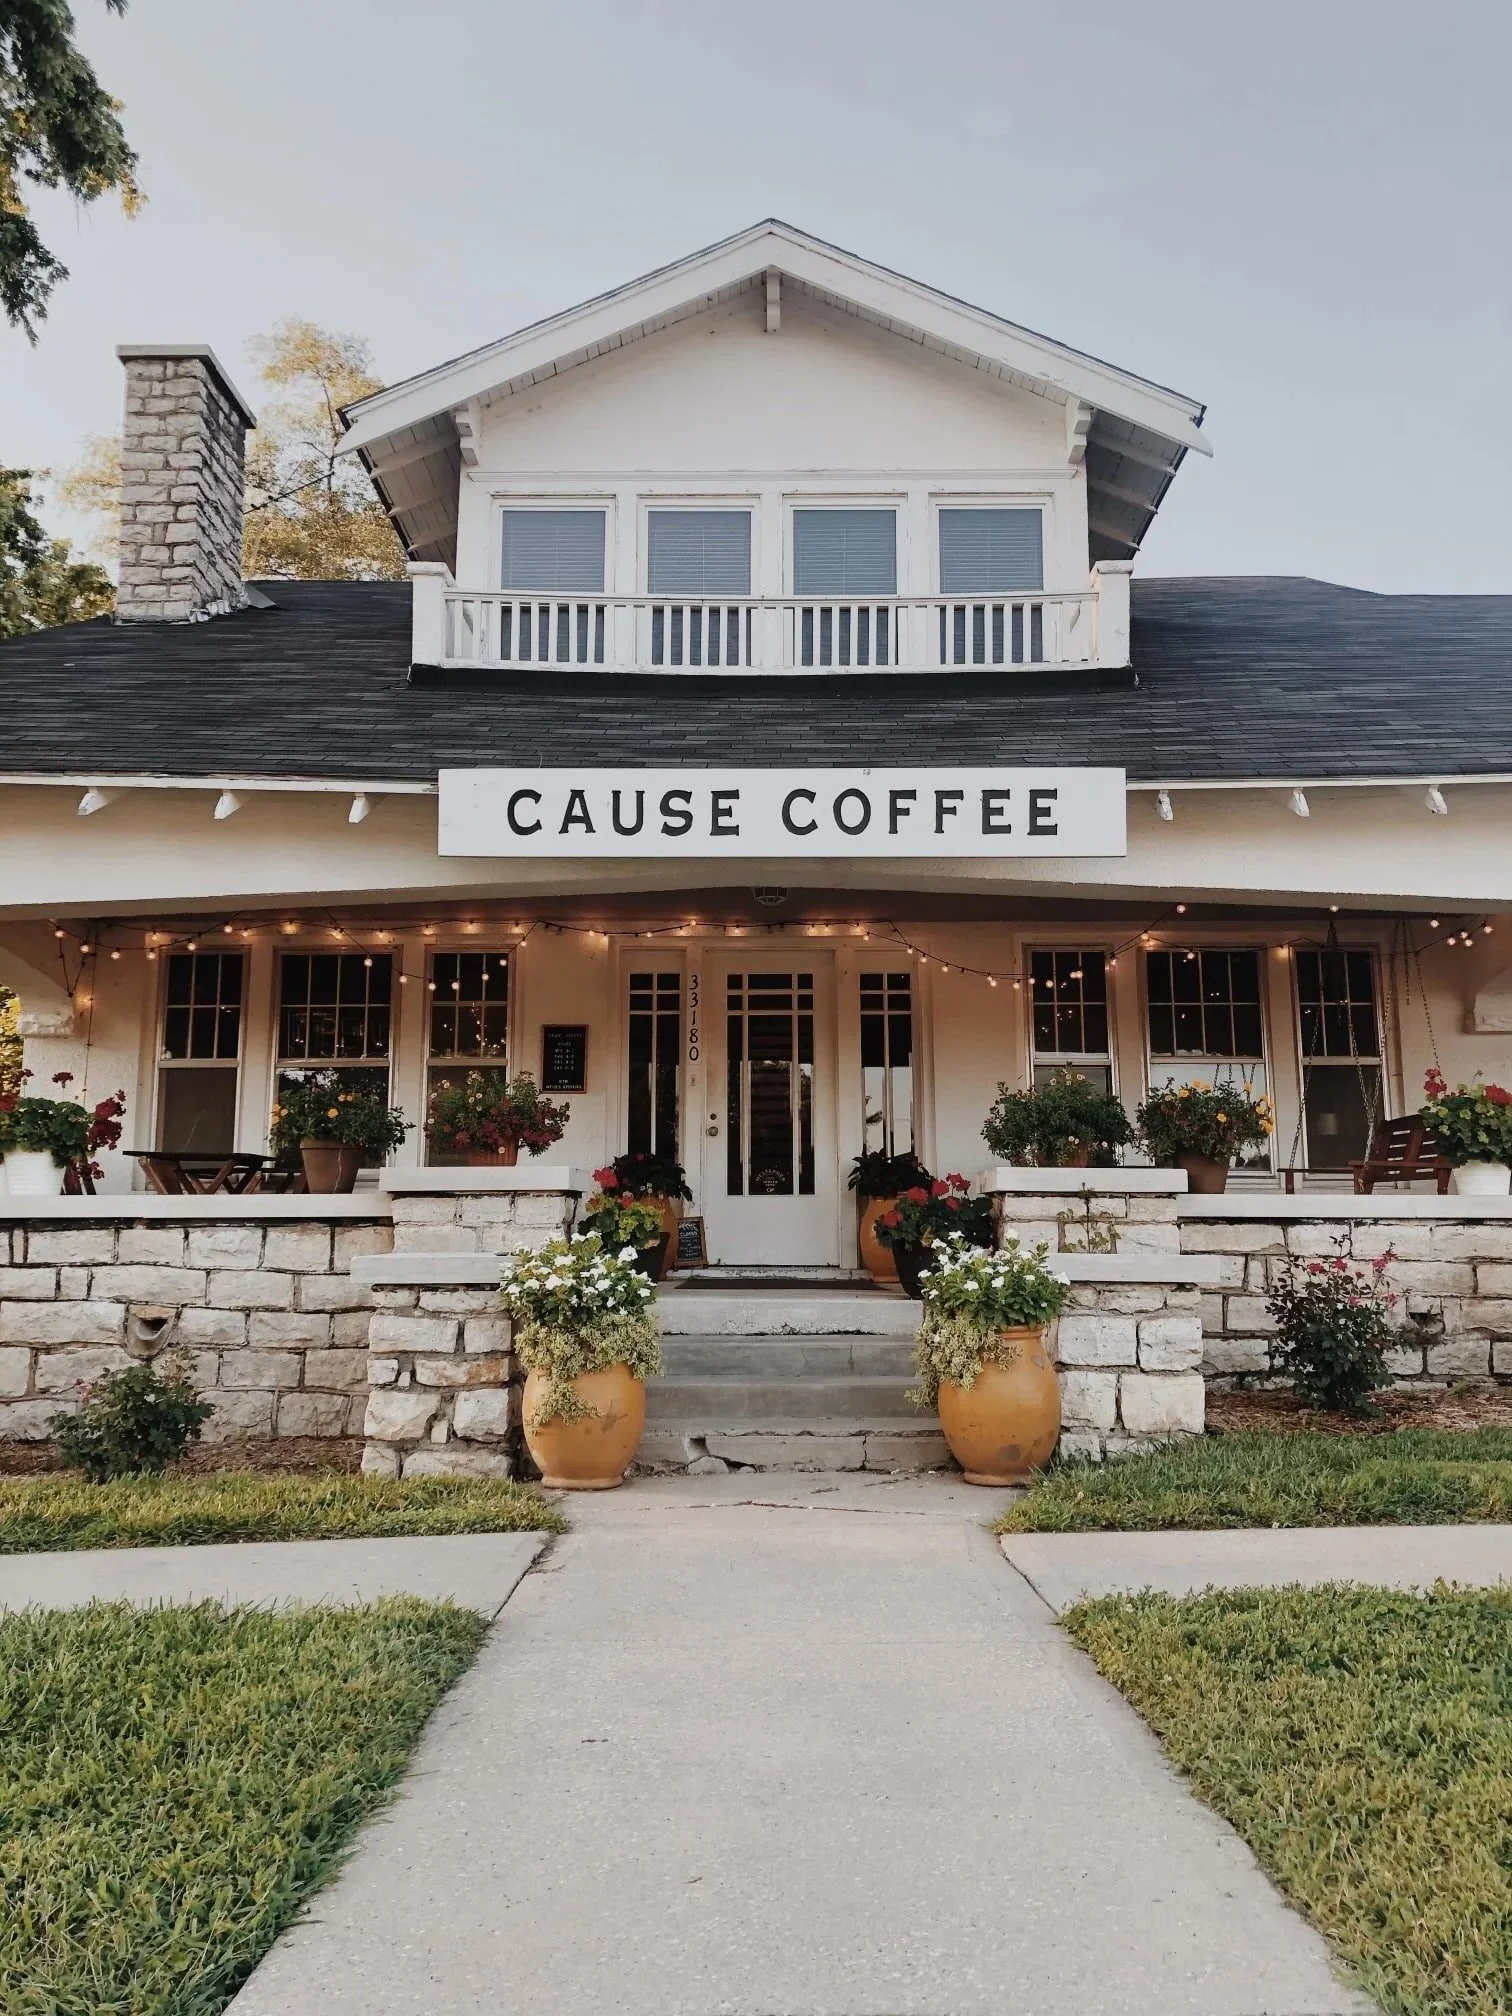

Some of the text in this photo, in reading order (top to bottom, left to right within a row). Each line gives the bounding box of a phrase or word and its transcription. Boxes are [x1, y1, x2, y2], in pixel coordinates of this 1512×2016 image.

[506, 787, 1059, 837] CAUSE COFFEE
[688, 974, 699, 1061] 33180
